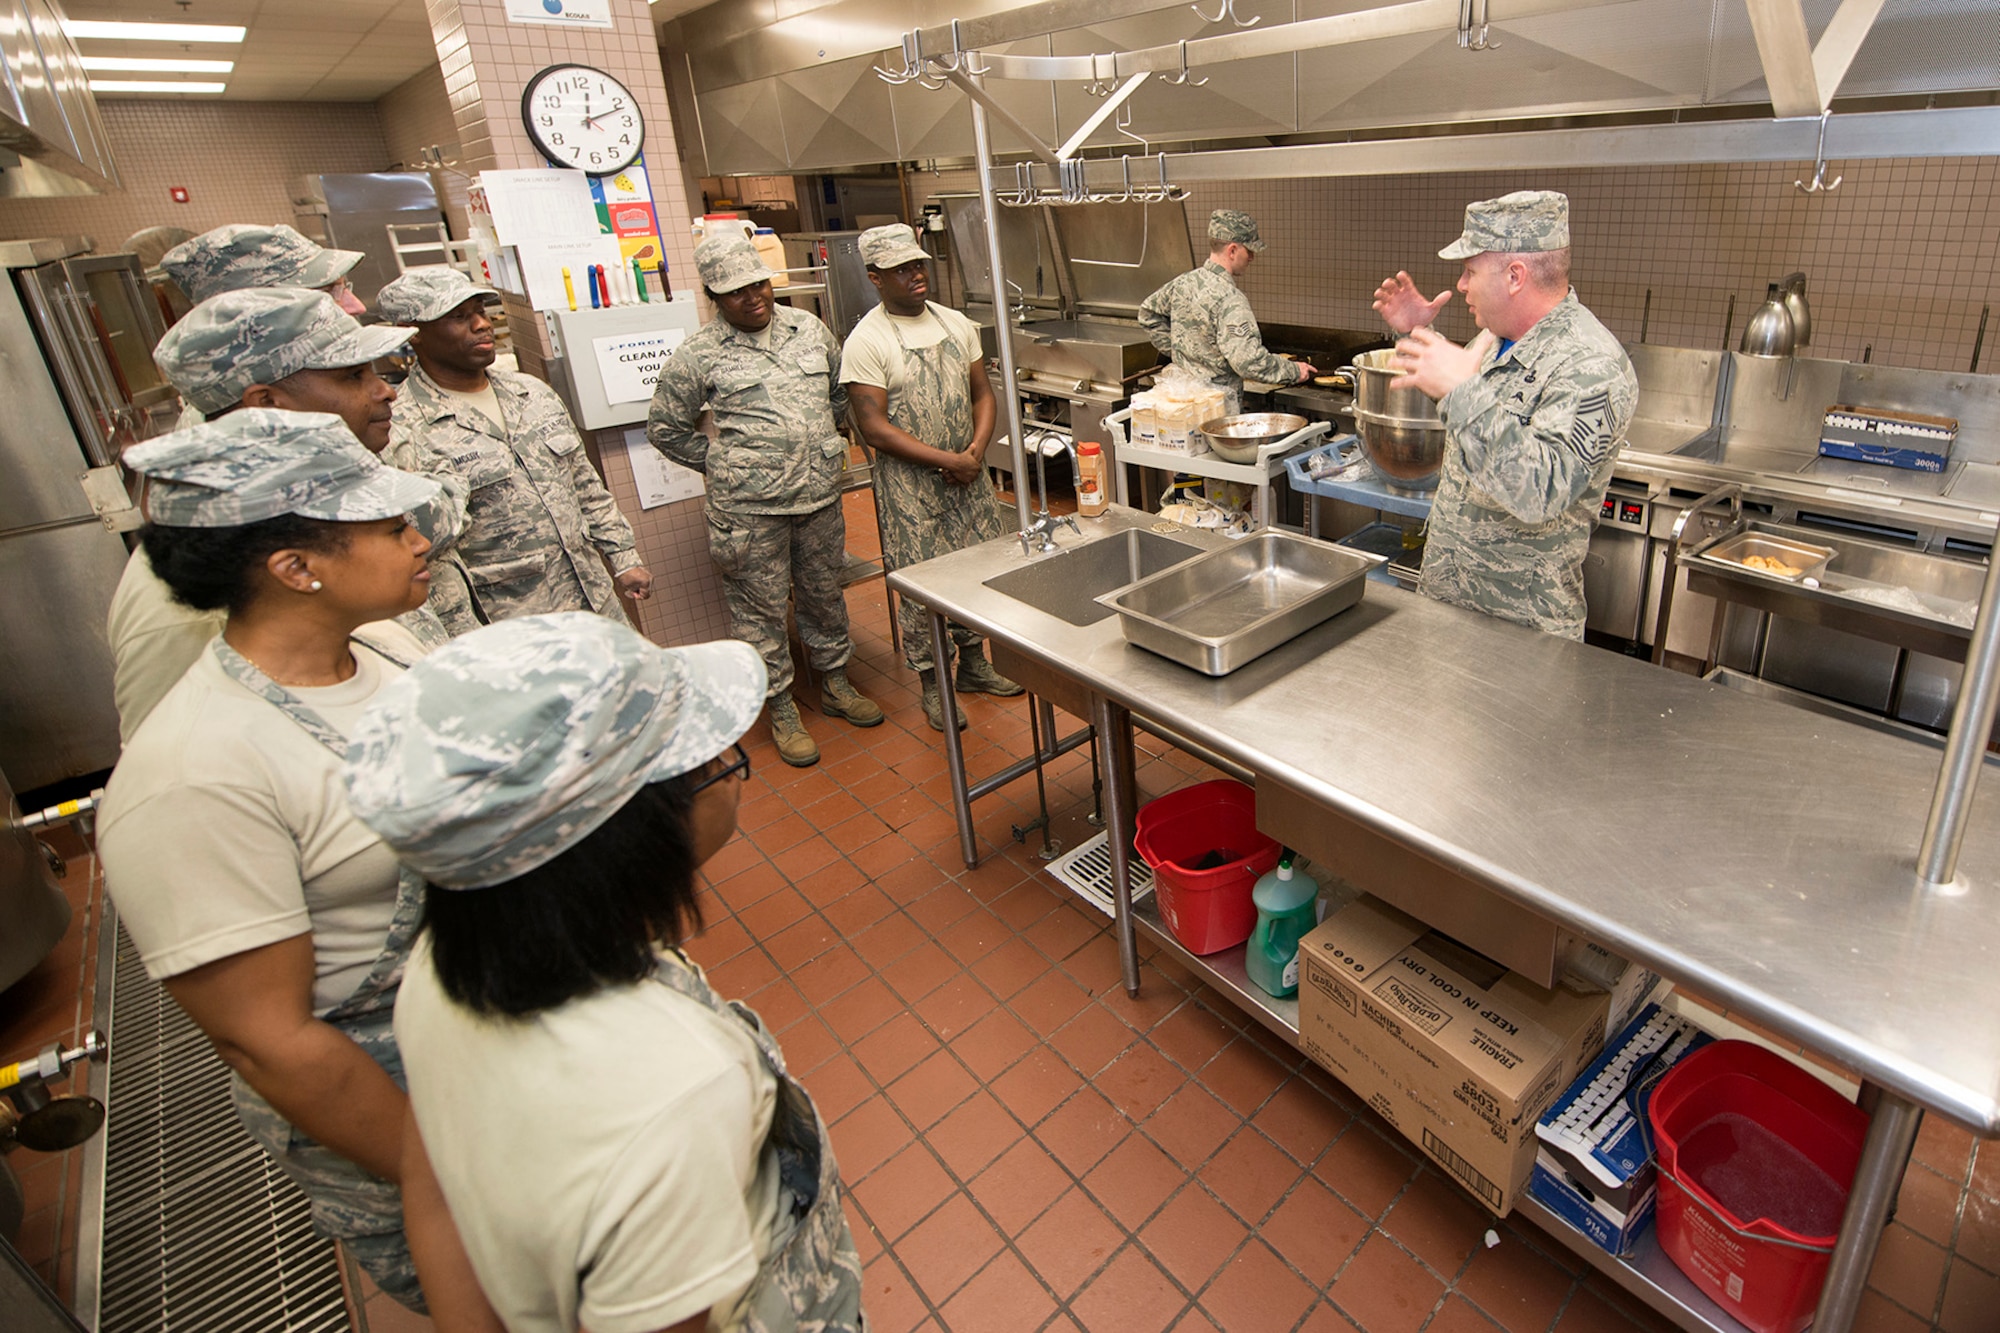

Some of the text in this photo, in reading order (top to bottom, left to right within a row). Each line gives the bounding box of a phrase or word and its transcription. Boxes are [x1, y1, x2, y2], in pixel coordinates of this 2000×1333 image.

[557, 82, 570, 94] 11
[572, 76, 590, 89] 12
[600, 83, 605, 95] 1
[543, 95, 562, 109] 10
[612, 97, 625, 110] 2
[540, 115, 554, 127] 9
[621, 115, 633, 128] 3
[551, 133, 564, 145] 8
[619, 133, 630, 145] 4
[570, 147, 580, 159] 7
[590, 152, 602, 164] 6
[608, 147, 620, 159] 5
[620, 348, 673, 362] CLEAN AS
[637, 363, 660, 372] YOU
[642, 376, 658, 385] GO
[1398, 956, 1426, 976] DRY
[1428, 973, 1462, 999] COOL
[1462, 996, 1480, 1010] IN
[1481, 1010, 1519, 1036] KEEP
[1472, 1027, 1524, 1063] HANDLE WITH CARE
[1470, 1035, 1517, 1070] FRAGILE
[1462, 1082, 1501, 1120] 88031
